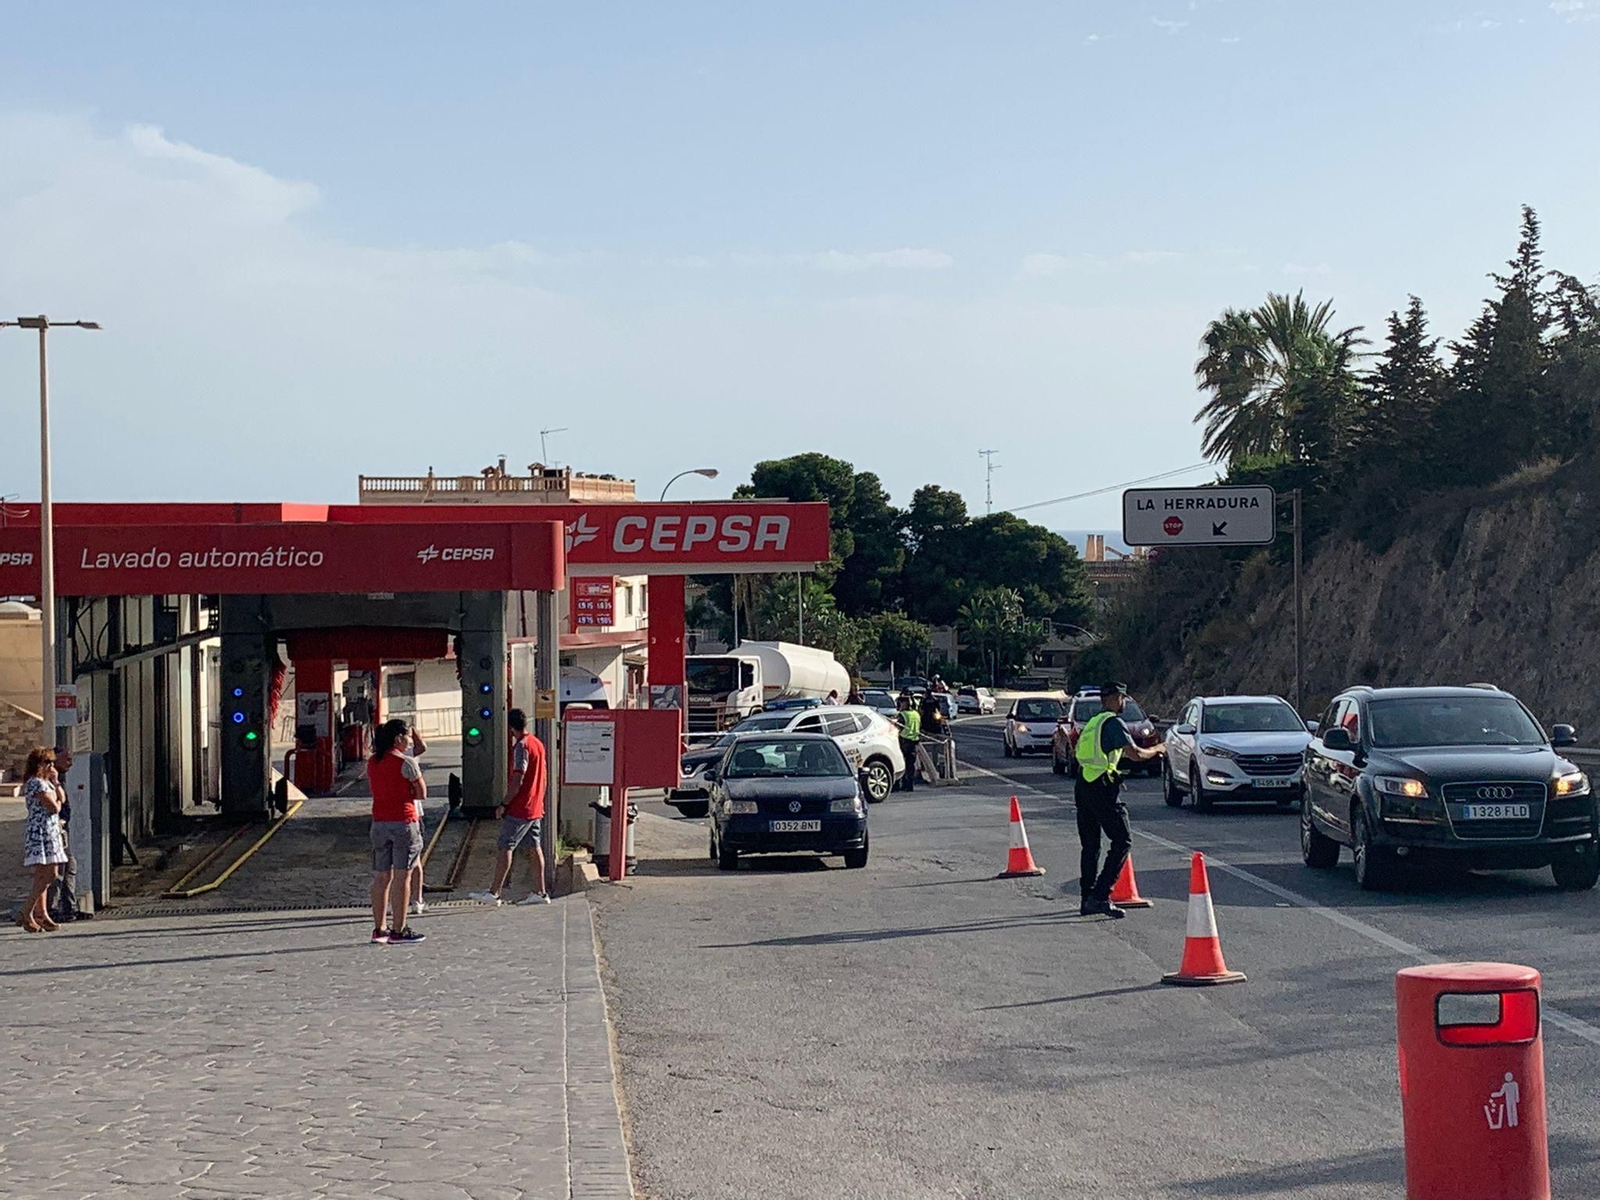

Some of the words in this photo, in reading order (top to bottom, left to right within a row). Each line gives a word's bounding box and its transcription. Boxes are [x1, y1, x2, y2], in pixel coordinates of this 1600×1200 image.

[1136, 499, 1155, 511] LA
[1164, 497, 1260, 510] HERRADURA
[612, 515, 791, 553] CEPSA
[80, 547, 172, 569] Lavado
[178, 546, 325, 568] automático
[441, 548, 495, 560] CEPSA
[1472, 806, 1502, 817] 1328
[1504, 806, 1527, 817] FLD
[775, 821, 798, 831] 0352
[801, 821, 820, 831] BNT
